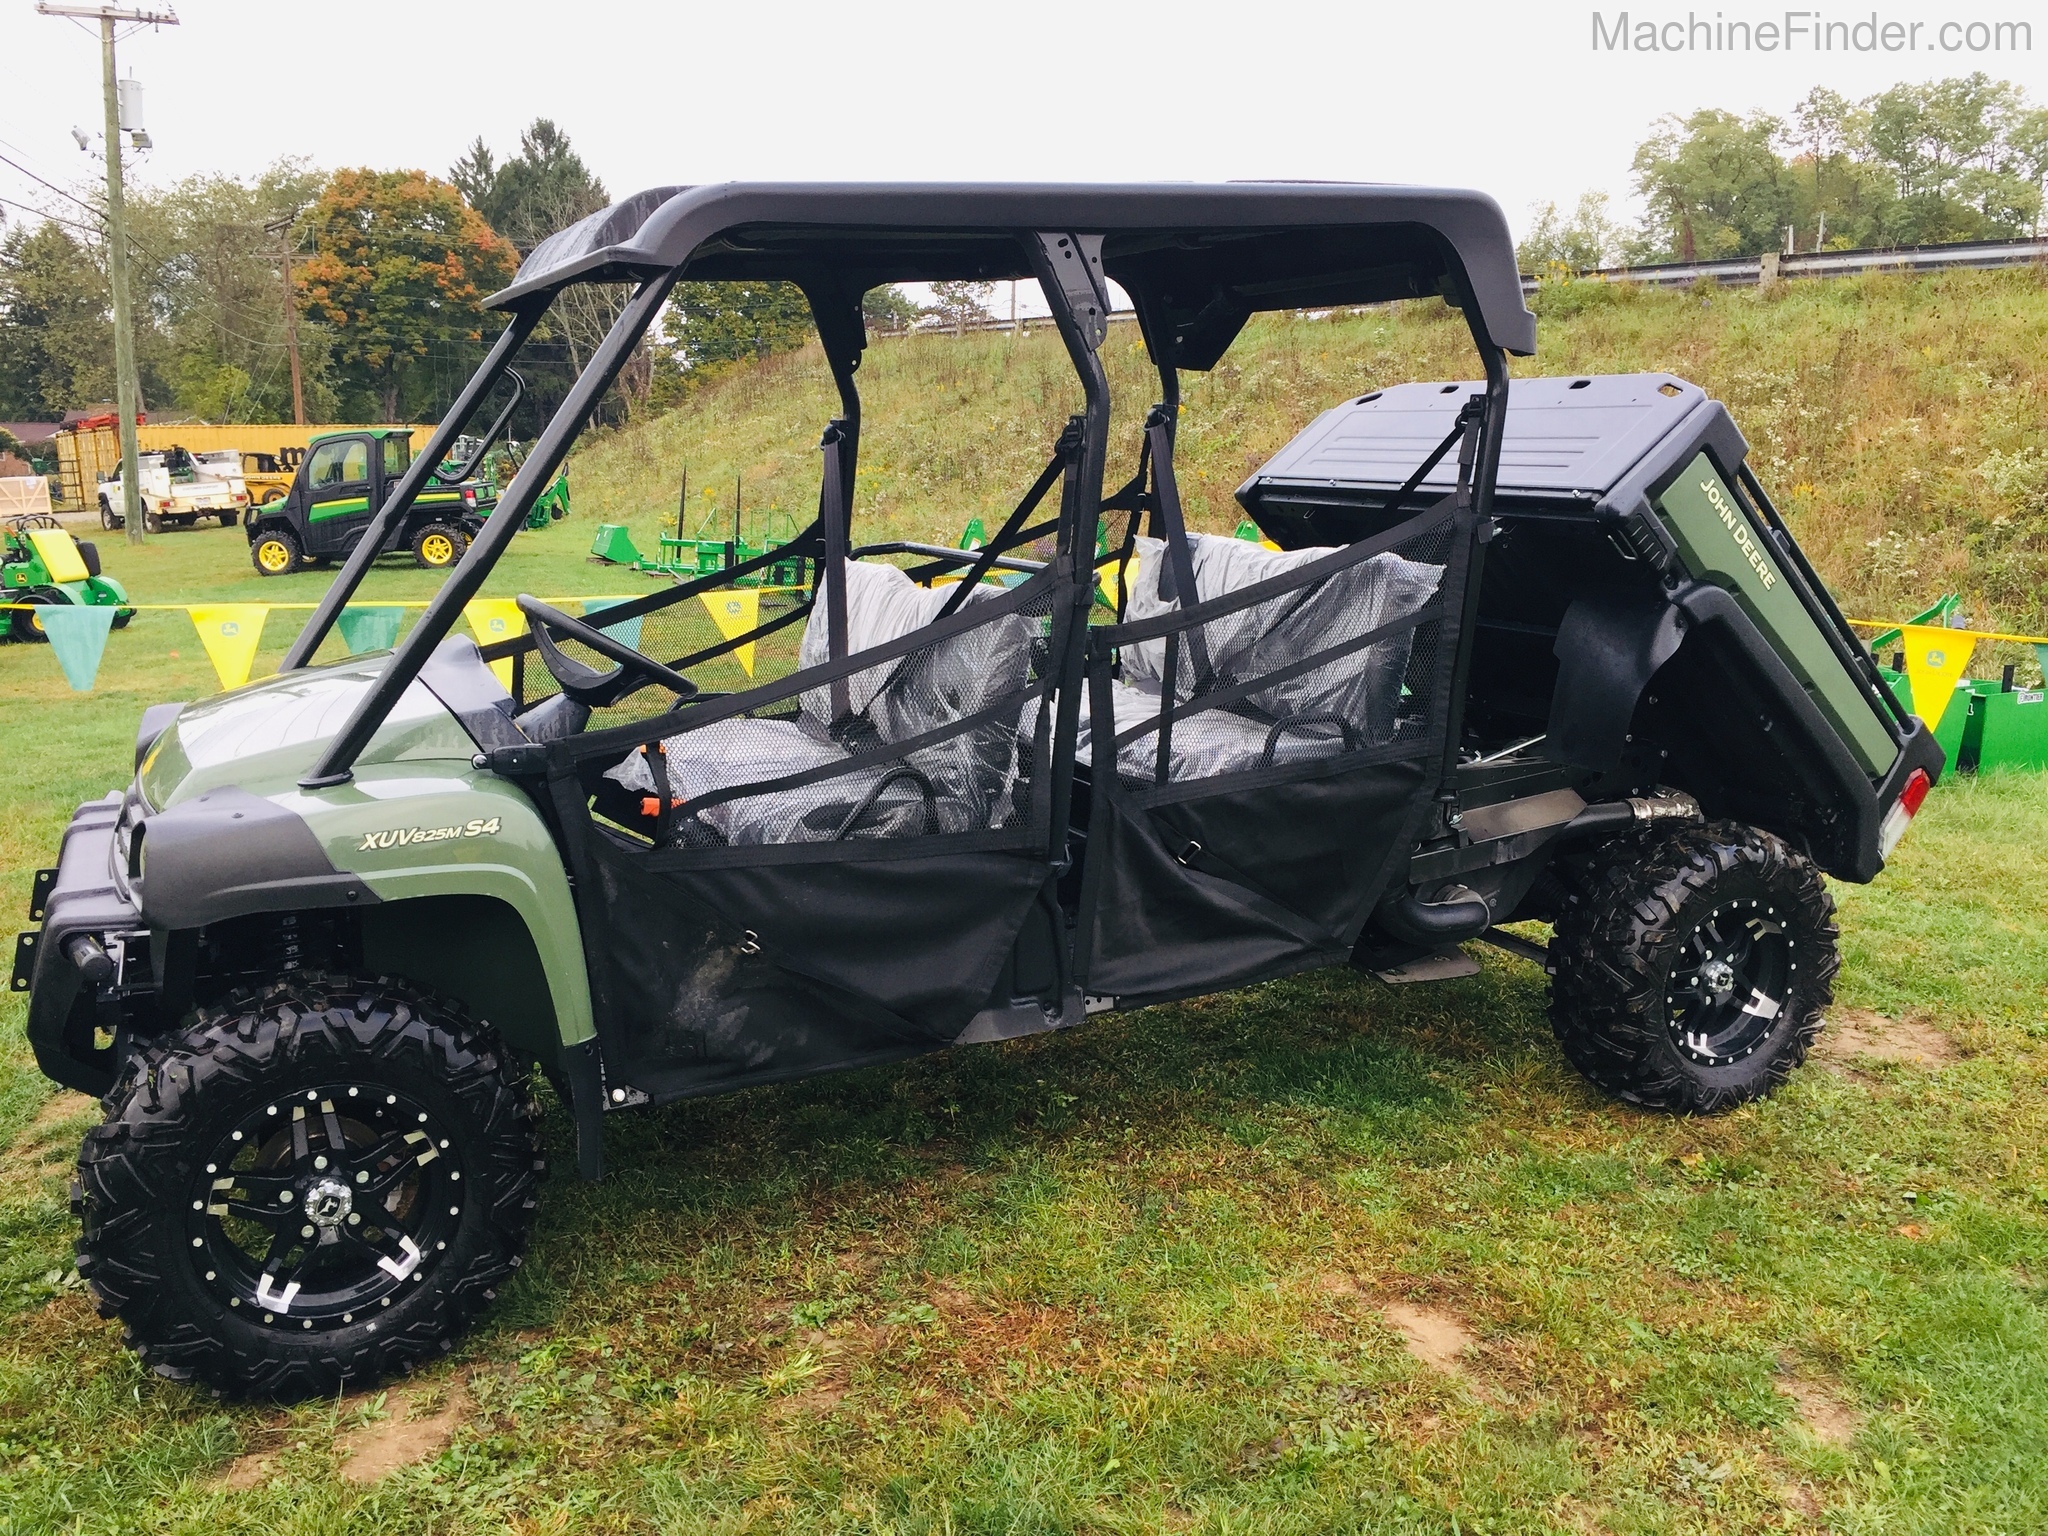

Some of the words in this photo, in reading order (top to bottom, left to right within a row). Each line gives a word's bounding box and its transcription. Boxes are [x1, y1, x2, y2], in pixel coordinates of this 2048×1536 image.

[1700, 478, 1738, 531] JOHN
[1732, 523, 1778, 592] DEERE
[356, 826, 464, 852] XUV825M
[464, 816, 502, 838] S4
